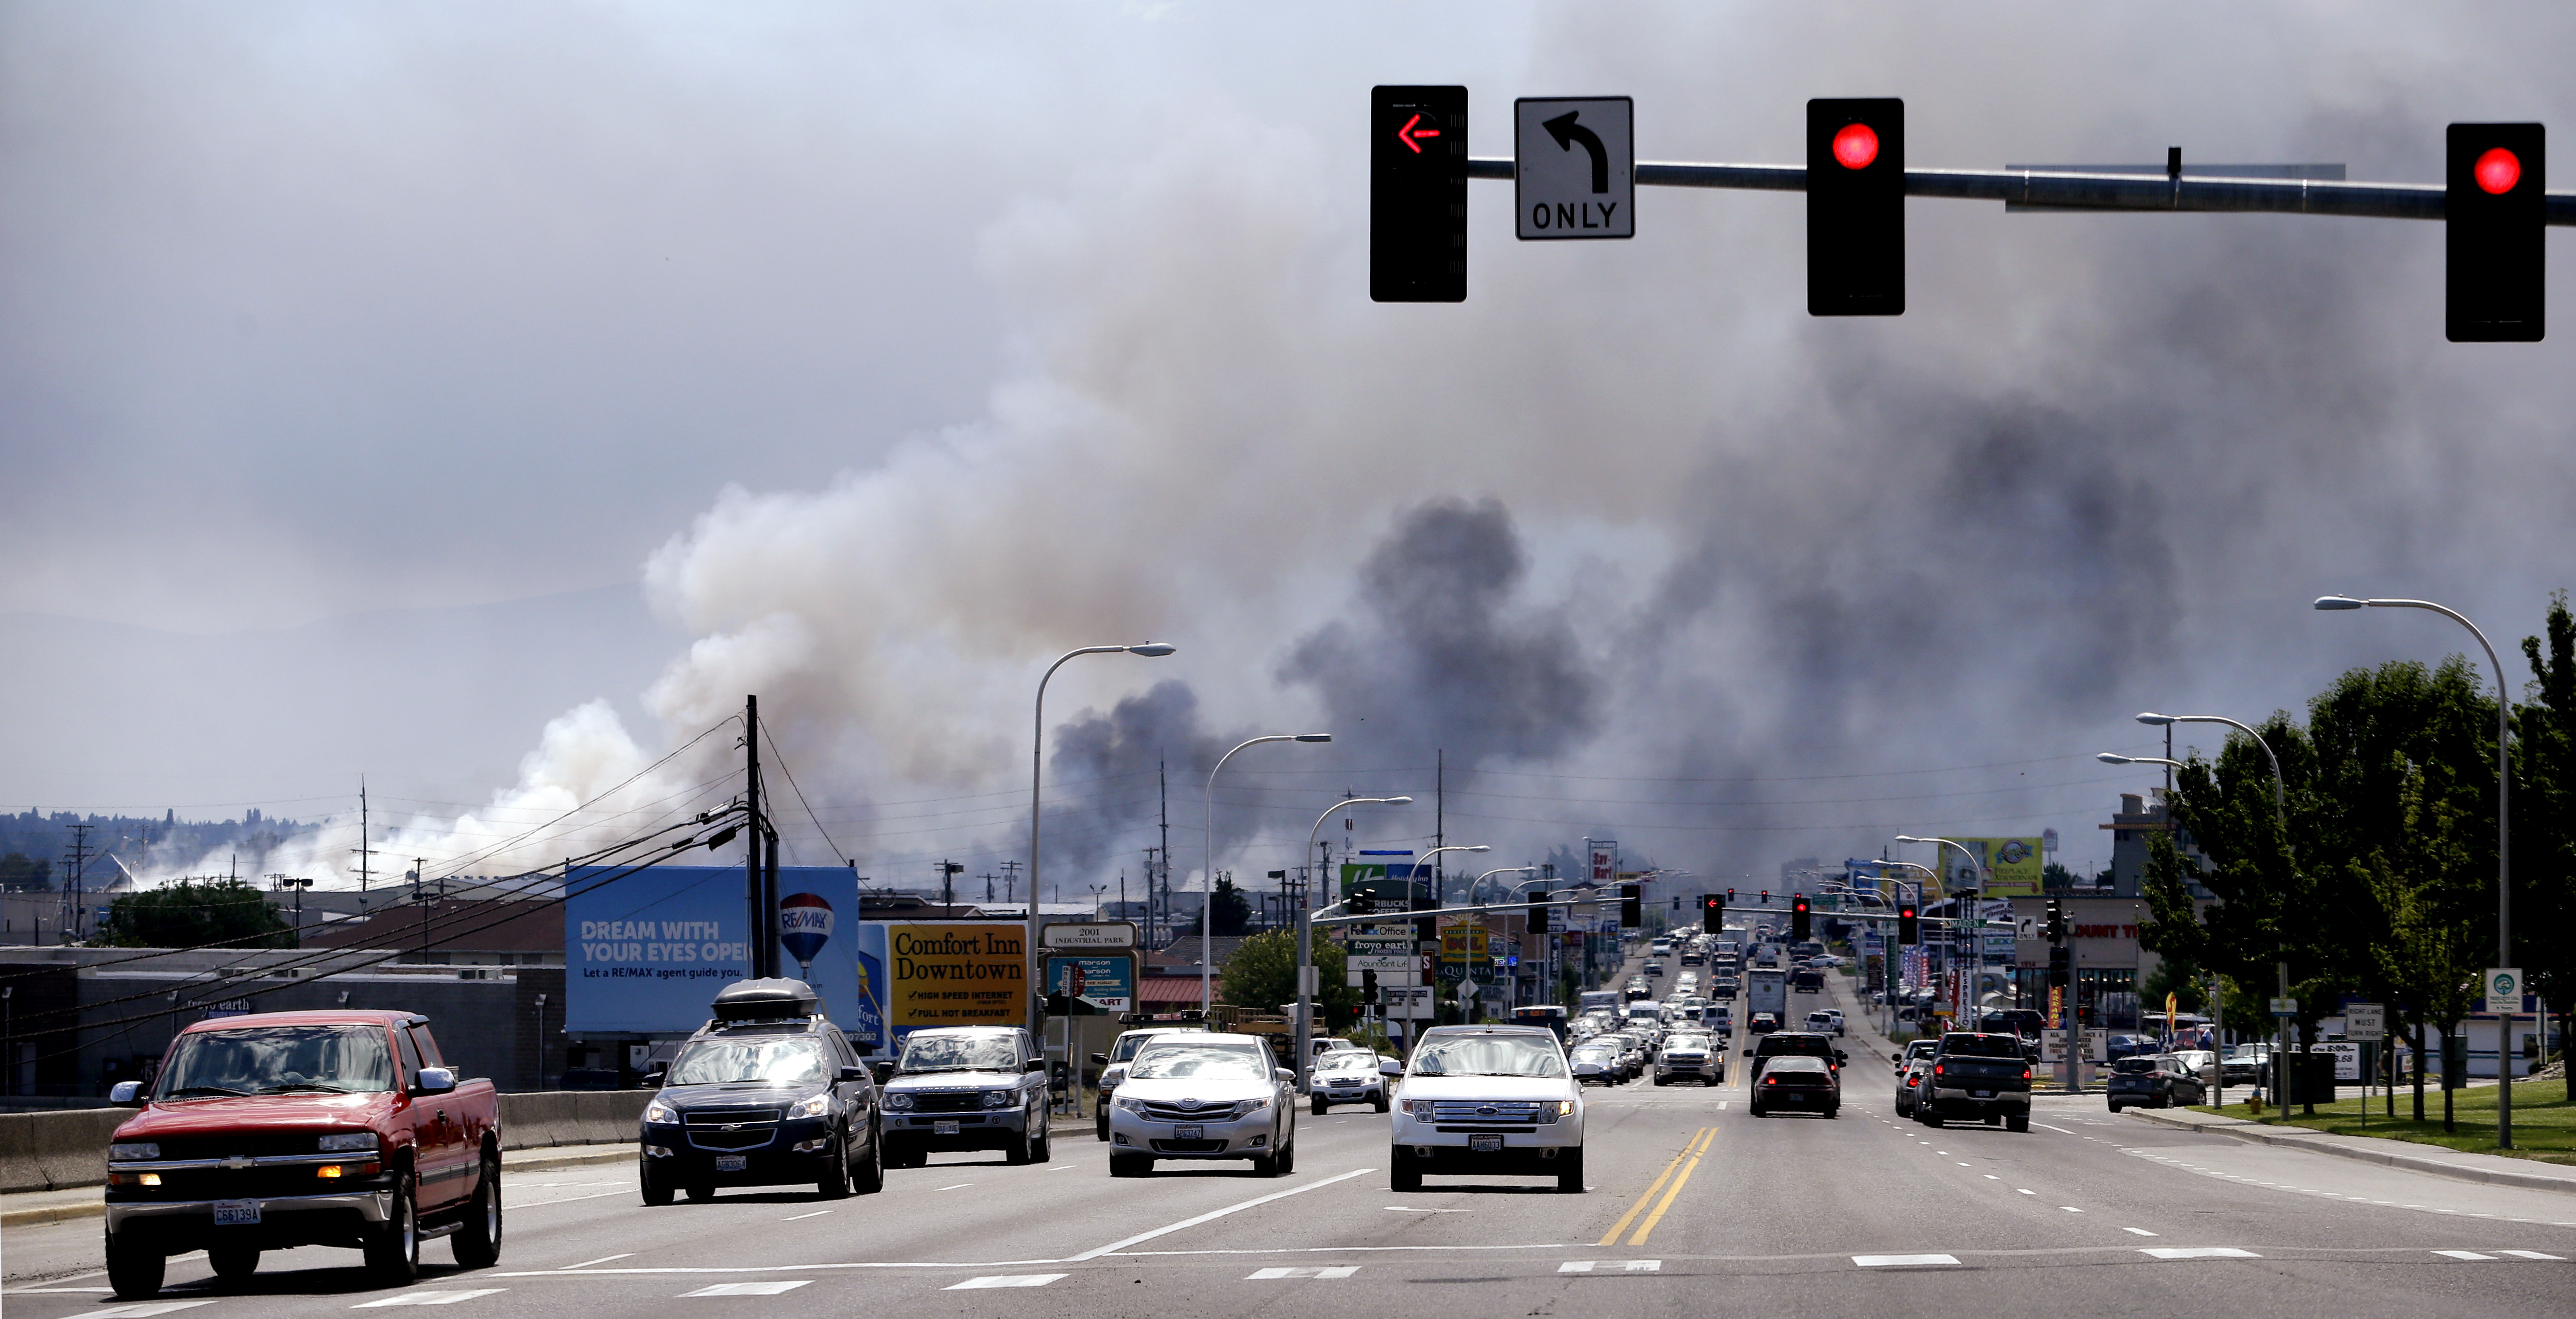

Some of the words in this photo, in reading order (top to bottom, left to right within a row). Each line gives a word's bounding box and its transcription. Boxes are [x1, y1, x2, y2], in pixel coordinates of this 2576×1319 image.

[1533, 202, 1617, 229] ONLY
[1391, 874, 1417, 883] Holidy
[781, 911, 827, 929] RE/MAX
[1952, 919, 1979, 928] MAIDEN
[582, 921, 656, 940] DREAM
[662, 921, 718, 940] WITH
[1379, 927, 1406, 935] Office
[895, 932, 981, 955] Comfort
[985, 933, 1022, 955] Inn
[1355, 941, 1382, 954] froyo
[1385, 941, 1413, 949] earth
[1446, 937, 1483, 951] SOL
[582, 943, 642, 962] YOUR
[647, 943, 697, 962] EYES
[896, 958, 1022, 980] Downtown
[1358, 959, 1395, 967] Abundant
[584, 968, 600, 977] Let
[612, 968, 652, 977] RE/MAX
[657, 969, 686, 980] agent
[690, 968, 717, 980] guide
[721, 969, 742, 979] you.
[1444, 965, 1492, 977] QUNTA
[220, 998, 250, 1011] earth
[858, 1005, 879, 1025] fort
[962, 1009, 1010, 1017] BREAKFAST
[717, 1160, 746, 1168] AGB3064
[217, 1209, 258, 1221] C66139A
